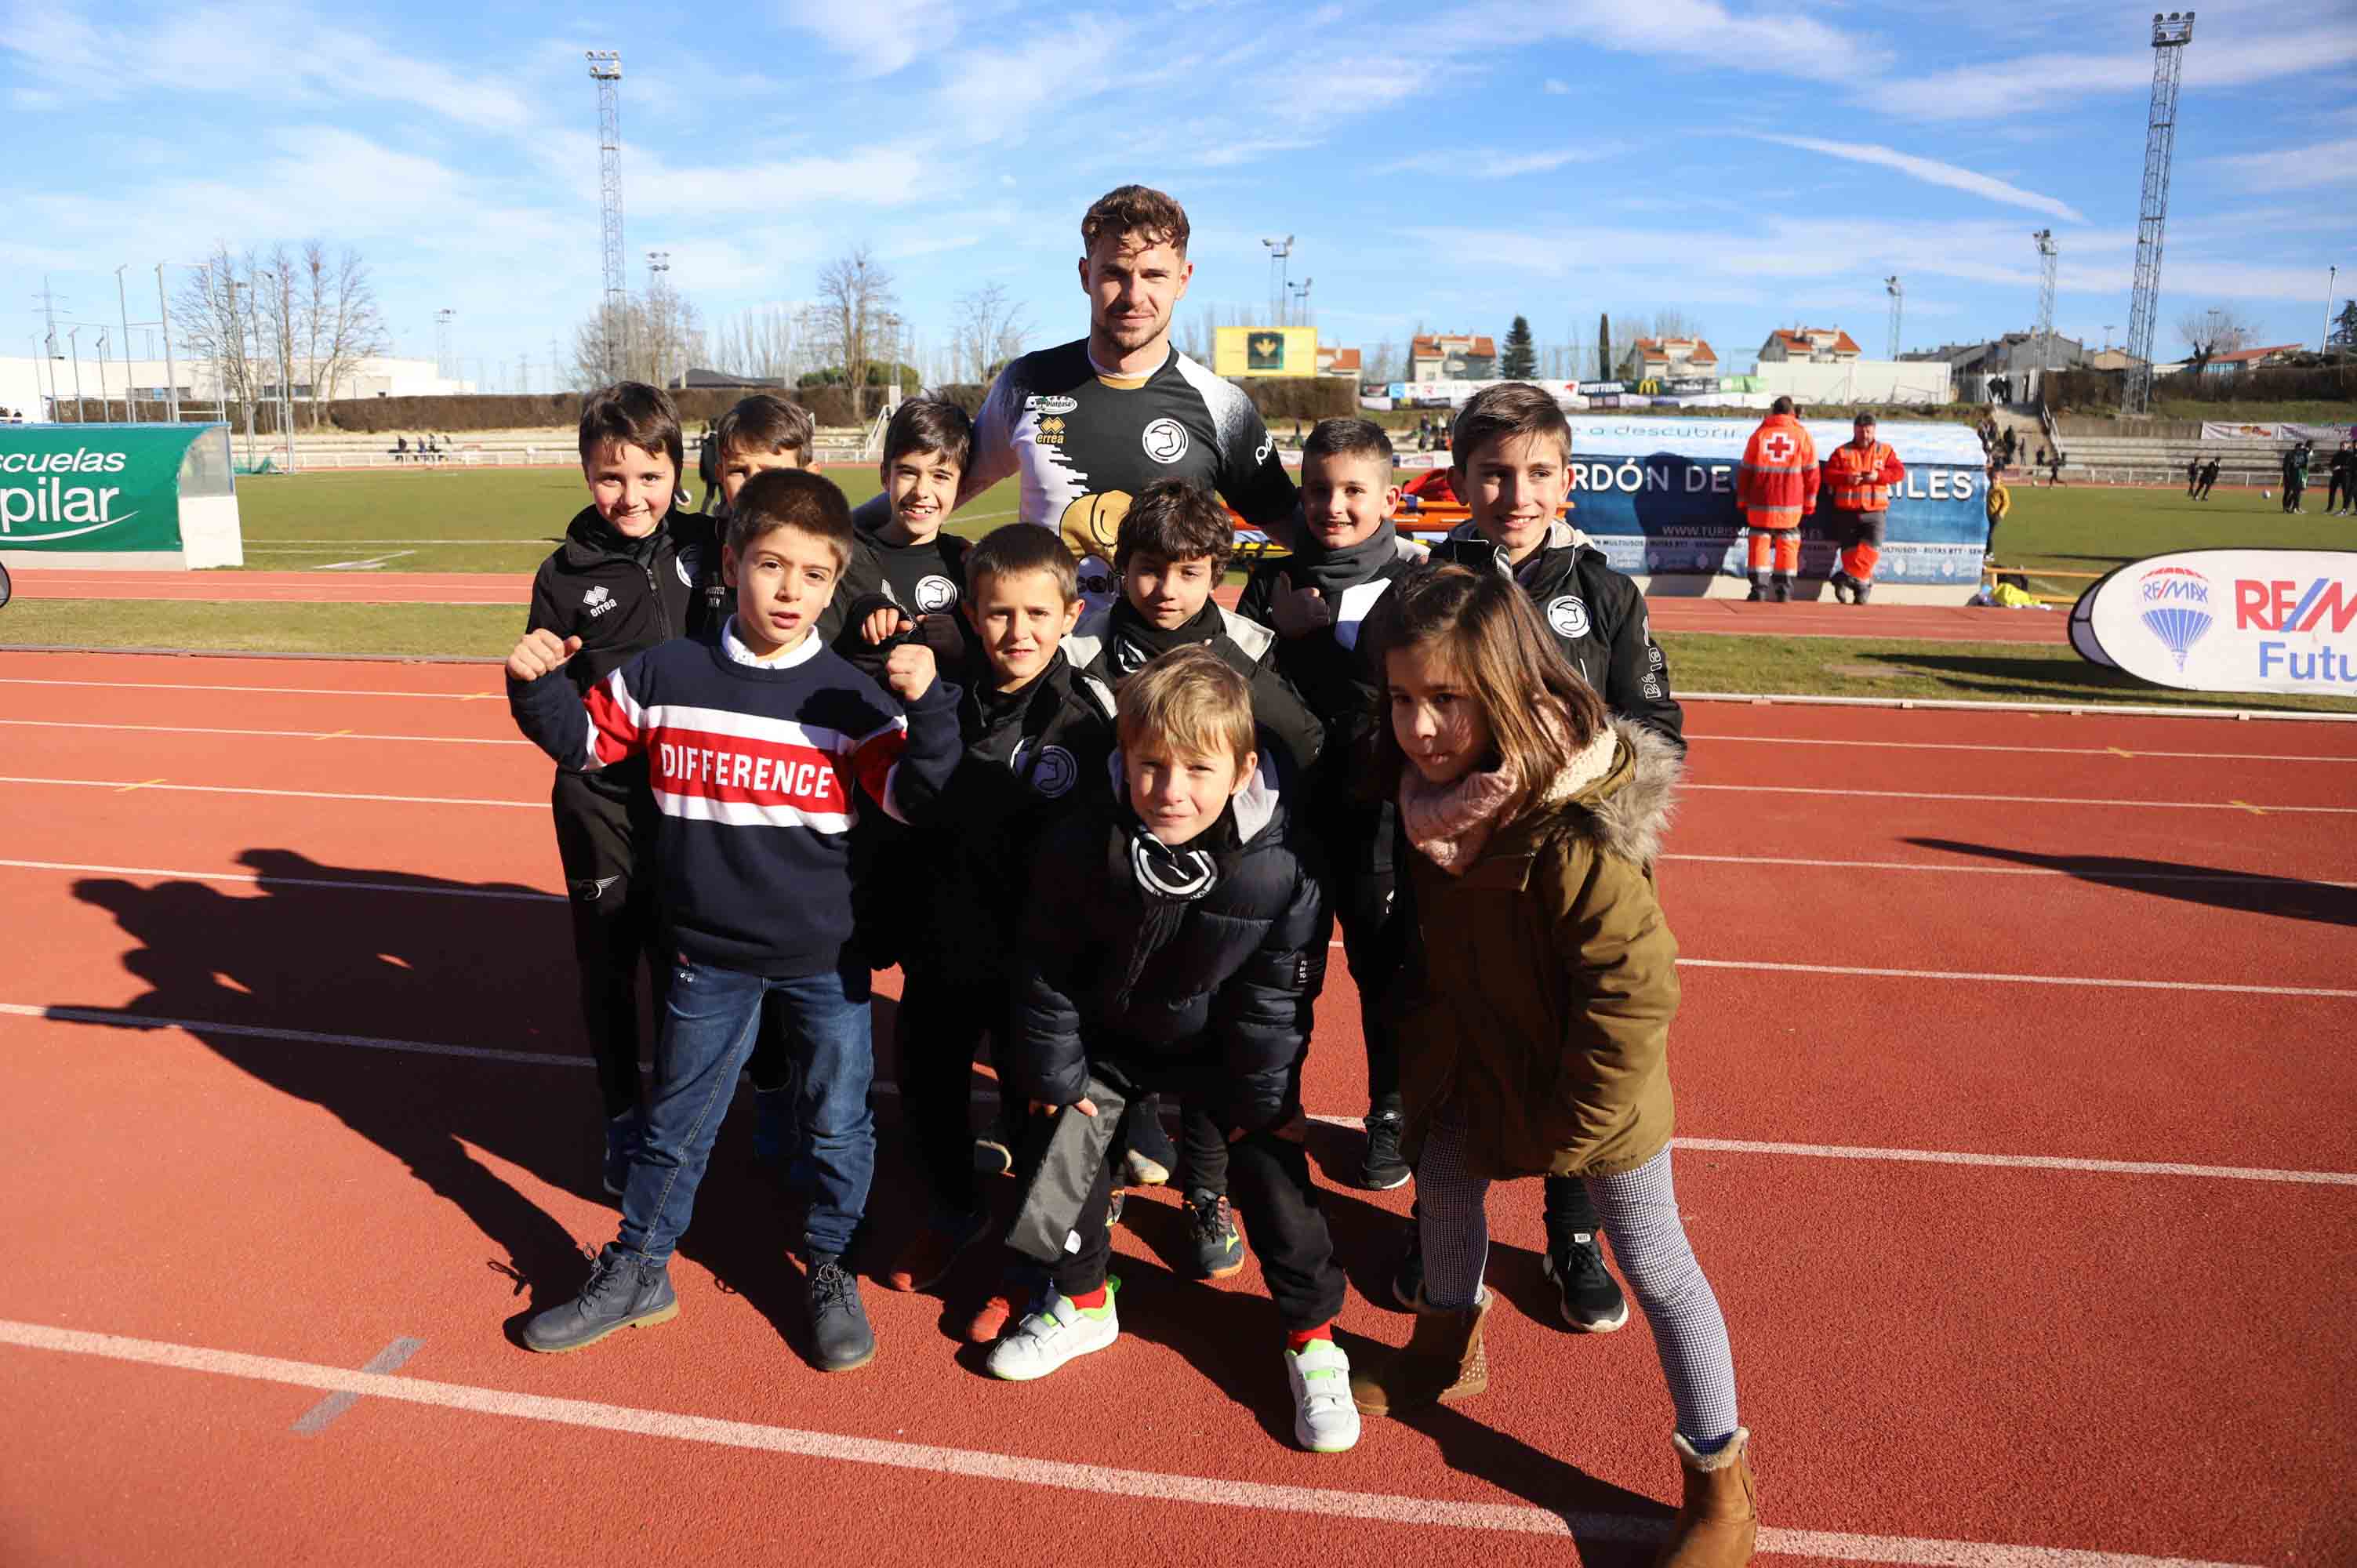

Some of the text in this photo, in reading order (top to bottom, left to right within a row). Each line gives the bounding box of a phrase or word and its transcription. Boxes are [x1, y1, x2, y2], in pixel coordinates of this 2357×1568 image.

[0, 447, 126, 473] cuelas
[1887, 470, 1974, 499] ILES
[0, 476, 120, 533] pilar
[2142, 578, 2209, 603] RE/MAX
[660, 742, 833, 799] DIFFERENCE
